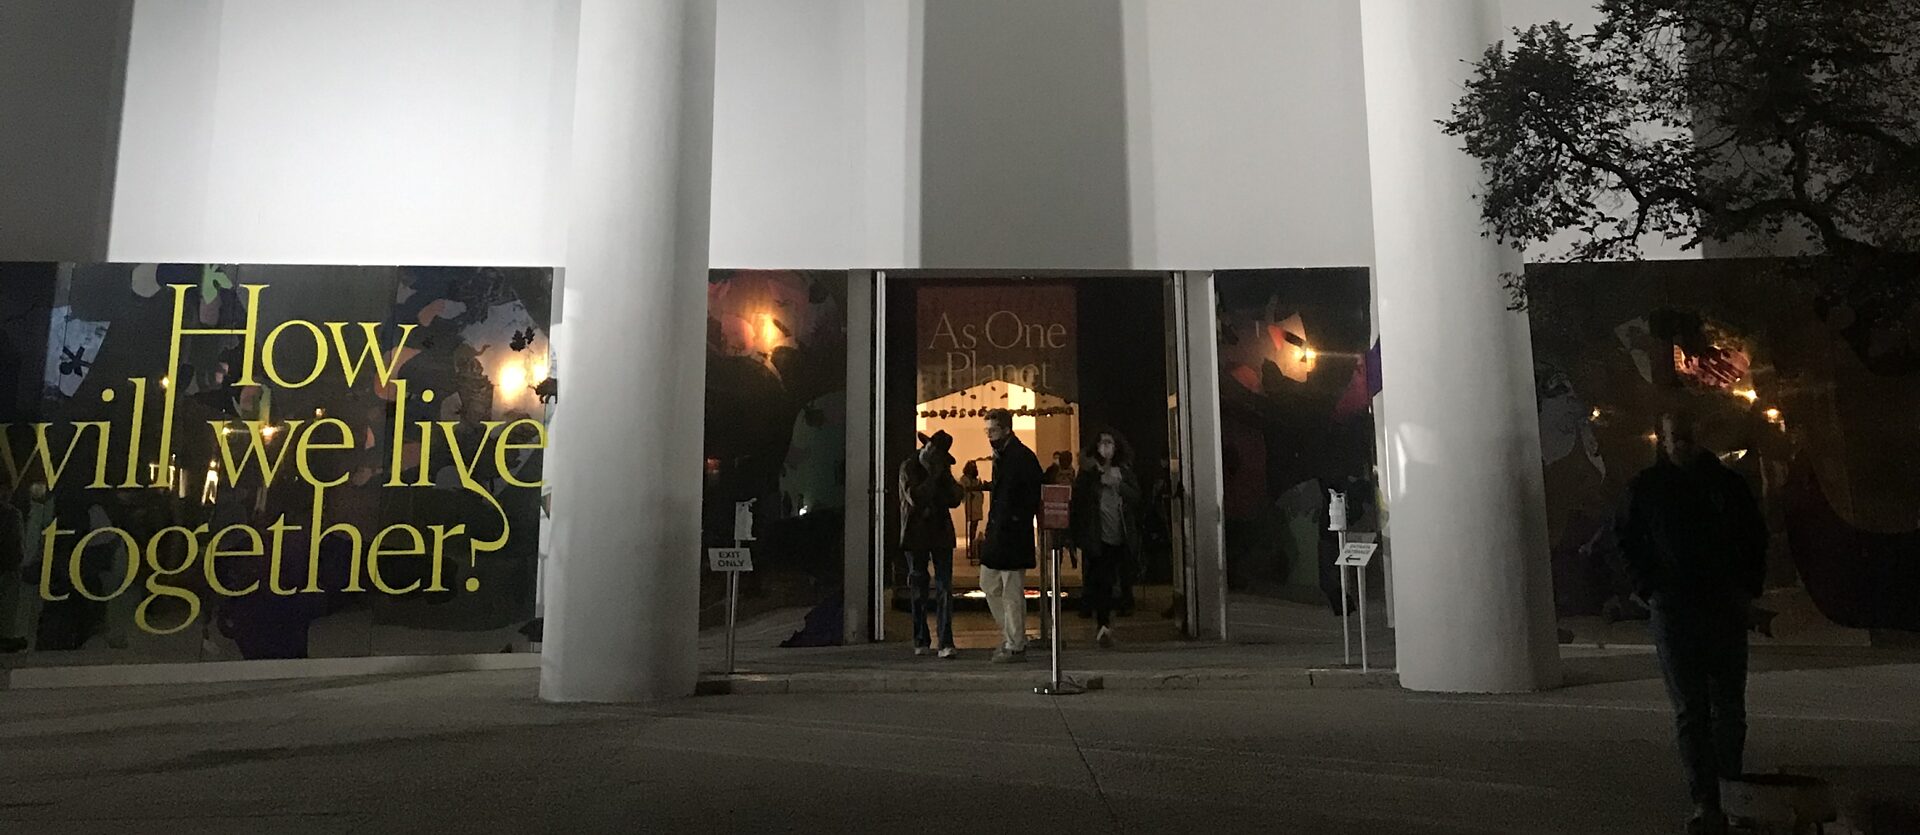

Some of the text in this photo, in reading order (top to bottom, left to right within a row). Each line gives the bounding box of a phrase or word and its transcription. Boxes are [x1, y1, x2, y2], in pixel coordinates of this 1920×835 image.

[167, 284, 418, 389] How
[928, 310, 1067, 350] As One
[946, 350, 1052, 390] Planet
[0, 377, 549, 490] will we live
[40, 486, 510, 634] together?
[718, 559, 744, 567] ONLY
